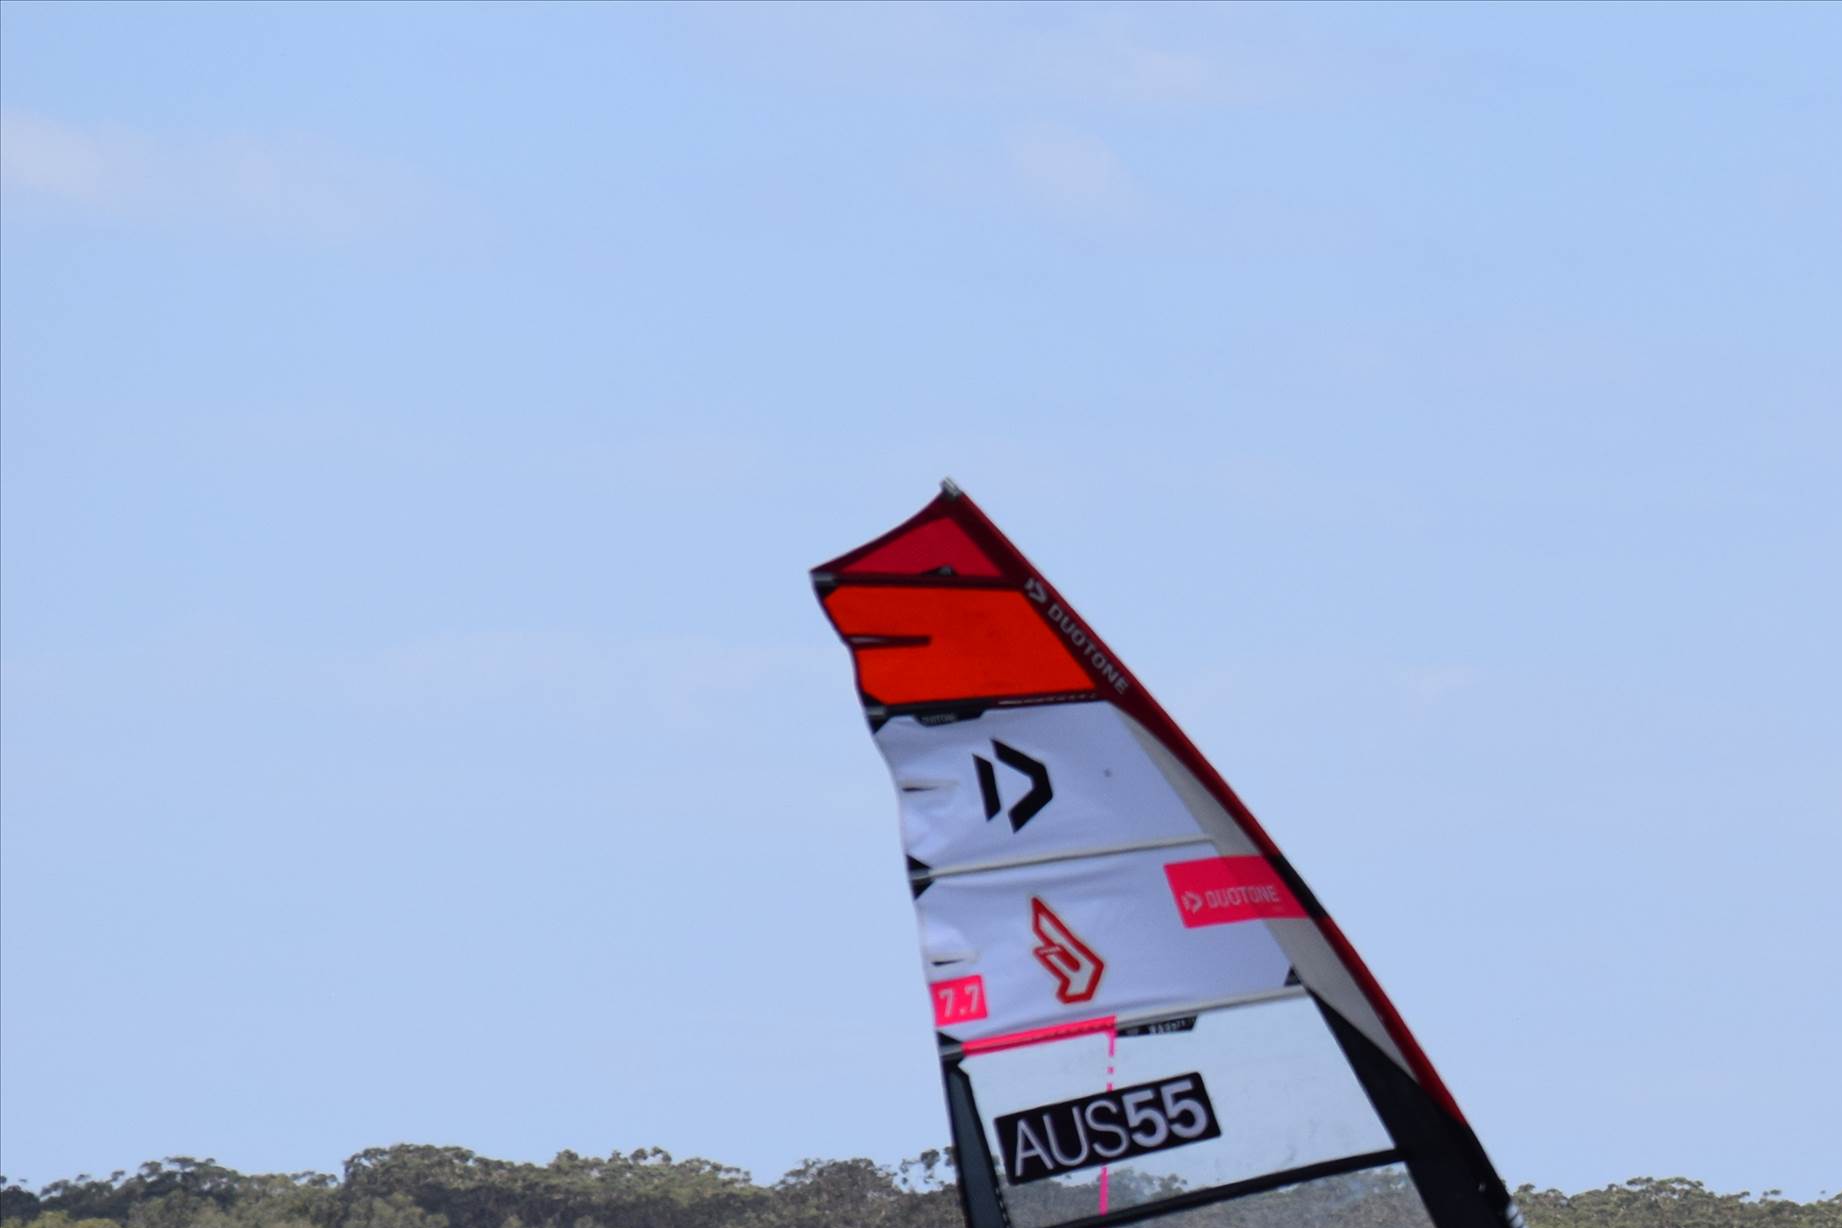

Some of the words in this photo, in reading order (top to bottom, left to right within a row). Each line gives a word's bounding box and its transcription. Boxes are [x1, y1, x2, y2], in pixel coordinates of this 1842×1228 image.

[1047, 603, 1129, 695] DUOTONE
[1204, 885, 1280, 909] DUOTONE
[939, 985, 978, 1017] 7.7
[1015, 1079, 1208, 1176] AUS55
